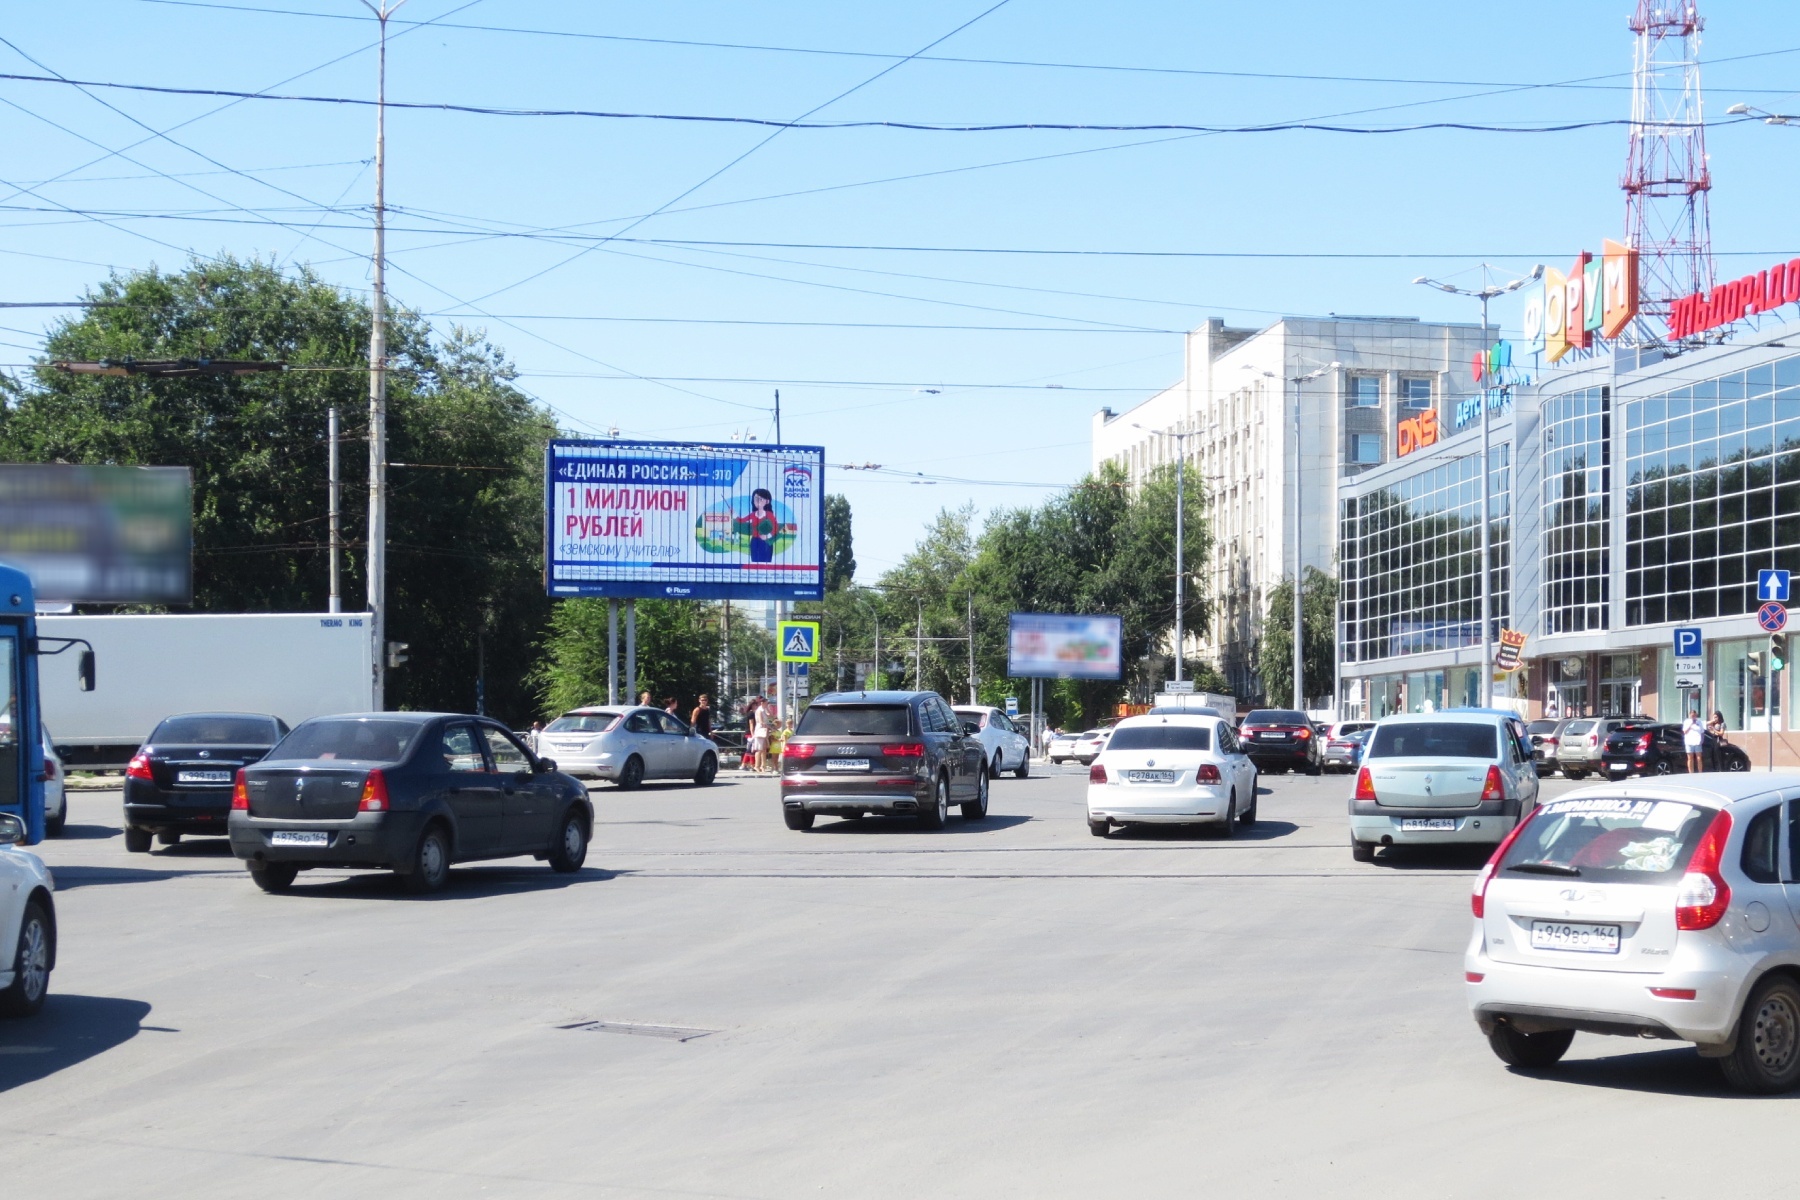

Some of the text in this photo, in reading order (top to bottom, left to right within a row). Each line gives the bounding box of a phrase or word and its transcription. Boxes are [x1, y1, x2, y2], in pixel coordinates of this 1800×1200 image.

[1524, 257, 1625, 344] ФОРУМ
[1456, 374, 1503, 428] Детсий
[1397, 408, 1437, 458] DNS
[559, 462, 626, 480] «ЕДИНАЯ
[631, 464, 697, 481] РОССИЯ»
[712, 469, 732, 480] ЭТО
[567, 488, 687, 511] 1 МИЛЛИОН
[566, 511, 643, 540] РУБЛЕЙ
[321, 619, 363, 627] THERMO KING
[1680, 631, 1697, 654] P
[311, 832, 327, 841] 164
[1537, 925, 1615, 945] А949ВО 164
